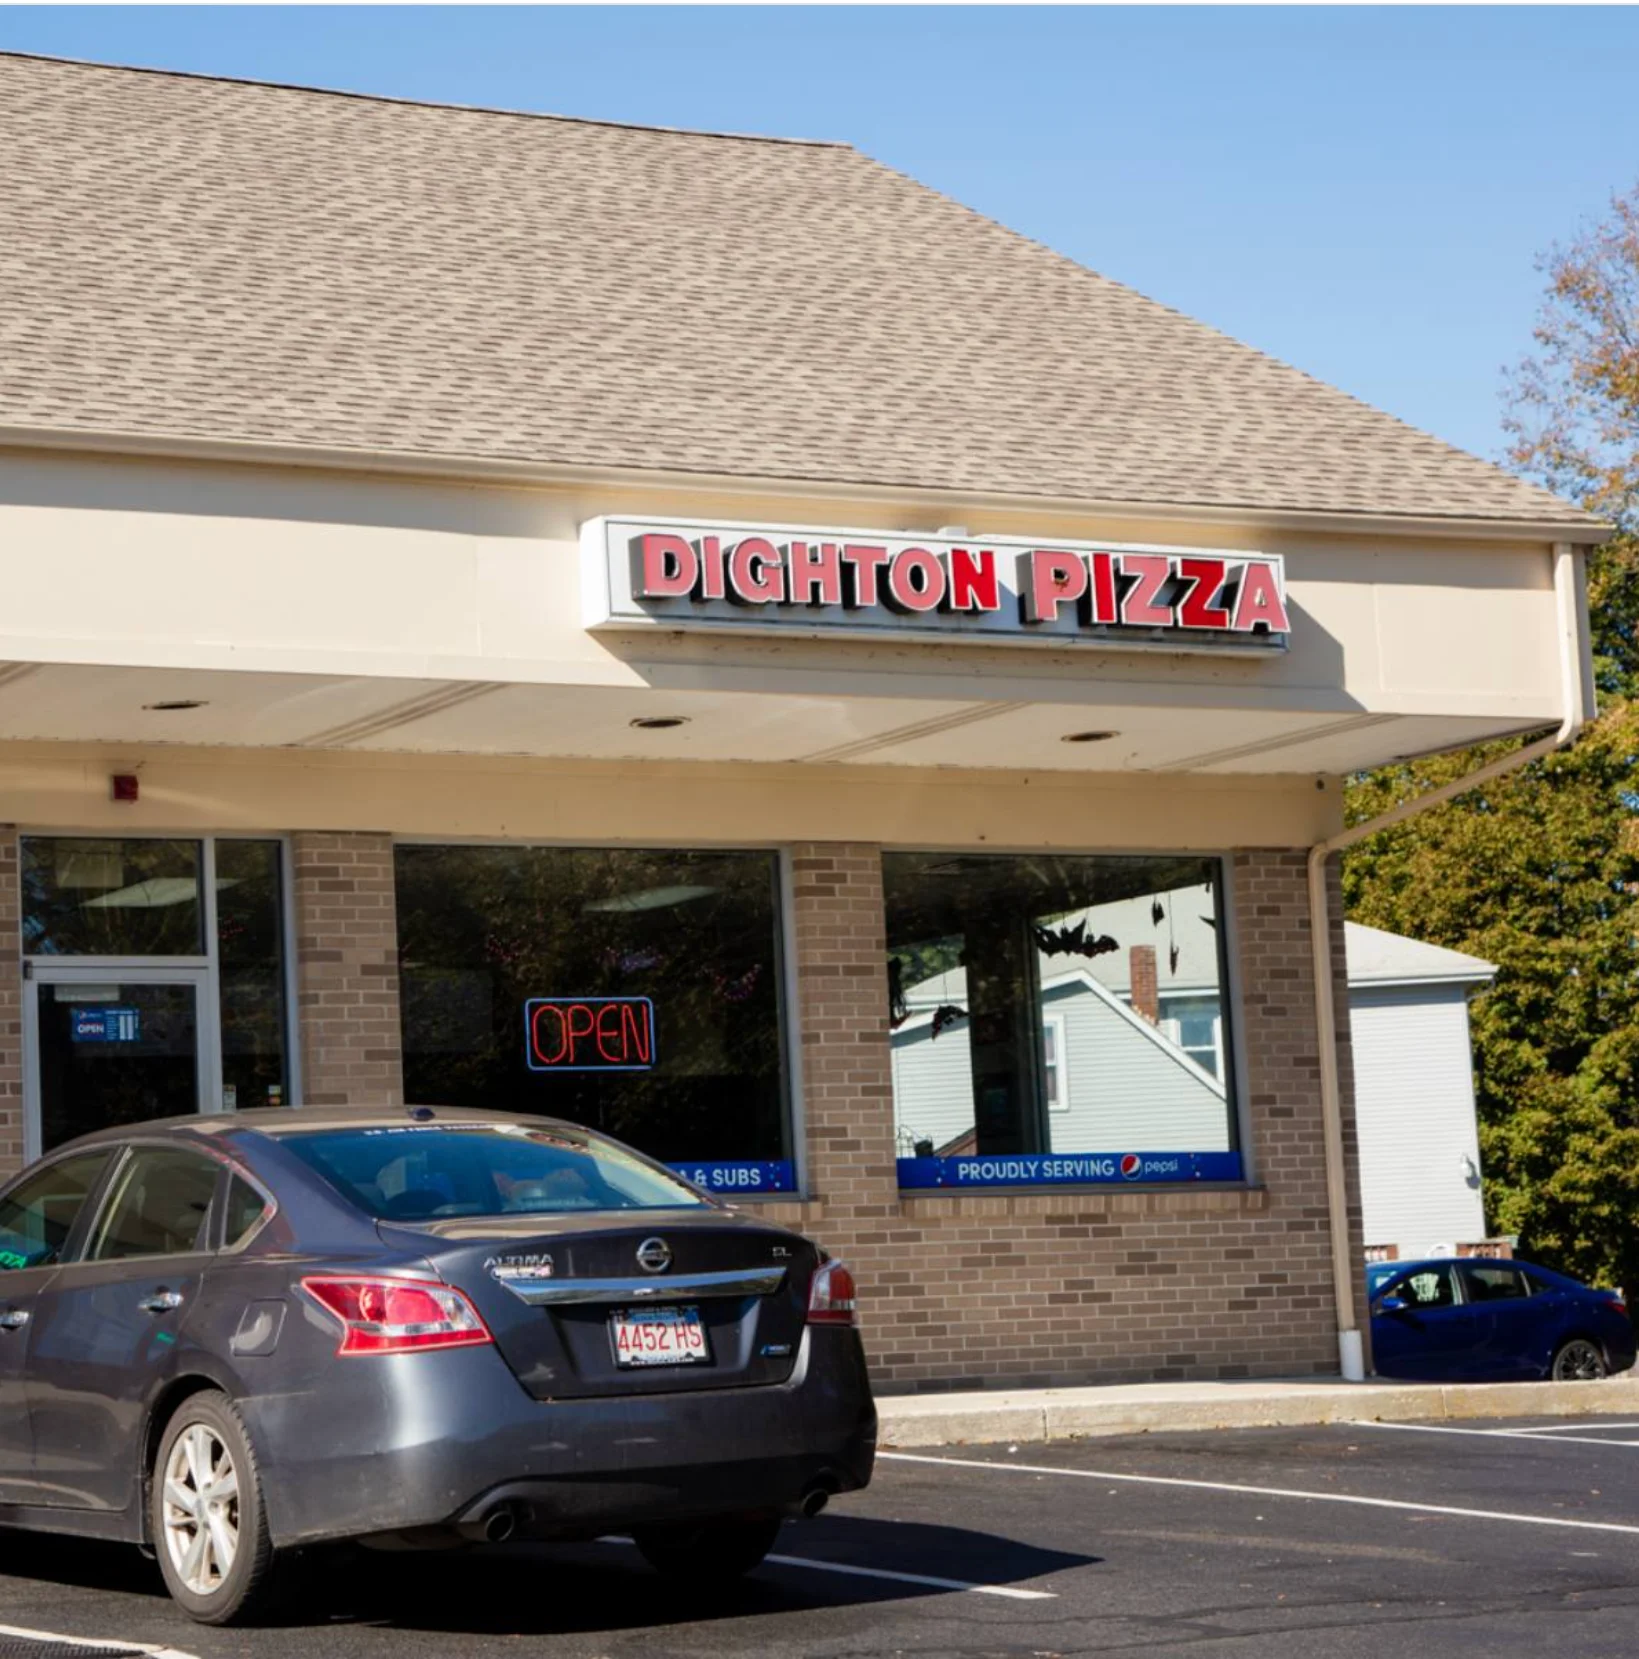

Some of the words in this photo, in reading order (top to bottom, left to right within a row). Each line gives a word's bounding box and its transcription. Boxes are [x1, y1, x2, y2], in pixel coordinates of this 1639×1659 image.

[641, 533, 1001, 611] DIGHTON
[1031, 548, 1291, 633] PIZZA
[77, 1023, 105, 1034] OPEN
[532, 1003, 650, 1064] OPEN
[694, 1168, 709, 1187] &
[712, 1167, 762, 1187] SUBS
[957, 1161, 1040, 1180] PROUDLY
[1042, 1159, 1115, 1178] SERVING
[1144, 1159, 1179, 1174] pepsi
[617, 1322, 671, 1352] 4452
[673, 1320, 702, 1348] HS
